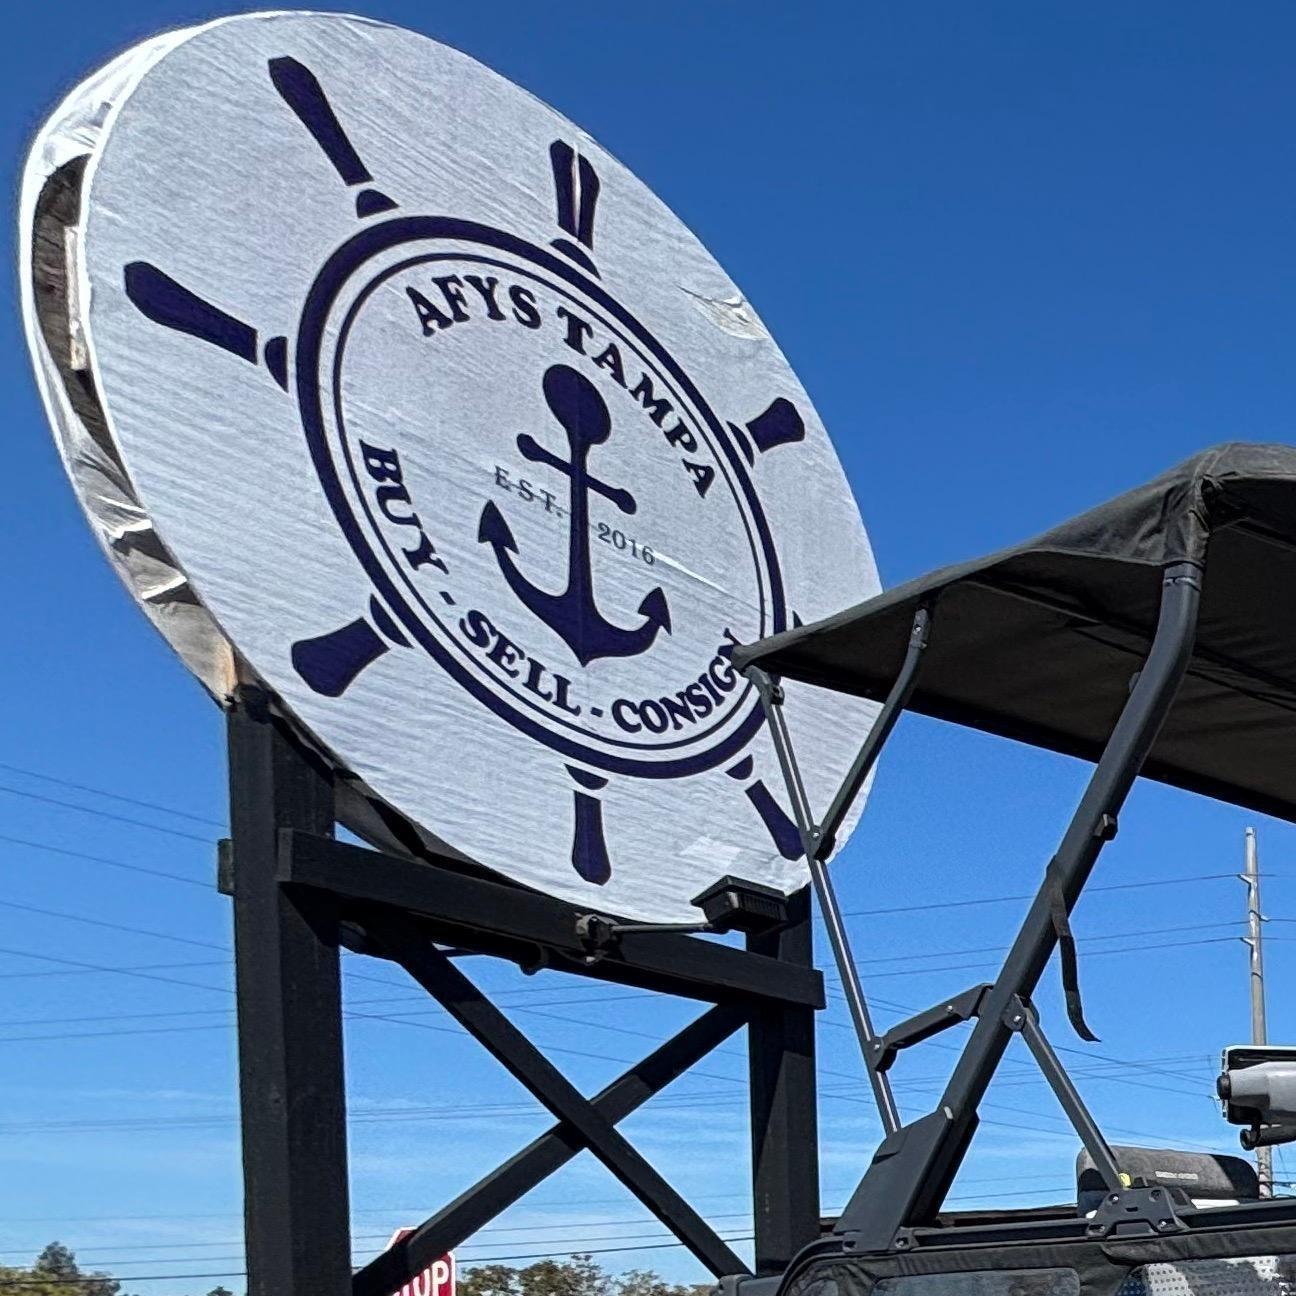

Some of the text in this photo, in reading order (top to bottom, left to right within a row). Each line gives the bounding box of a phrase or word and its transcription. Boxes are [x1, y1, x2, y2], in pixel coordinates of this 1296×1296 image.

[405, 273, 716, 499] AFYS TAMPA
[359, 439, 450, 575] BUY
[458, 609, 582, 717] SELL
[598, 522, 655, 566] 2016
